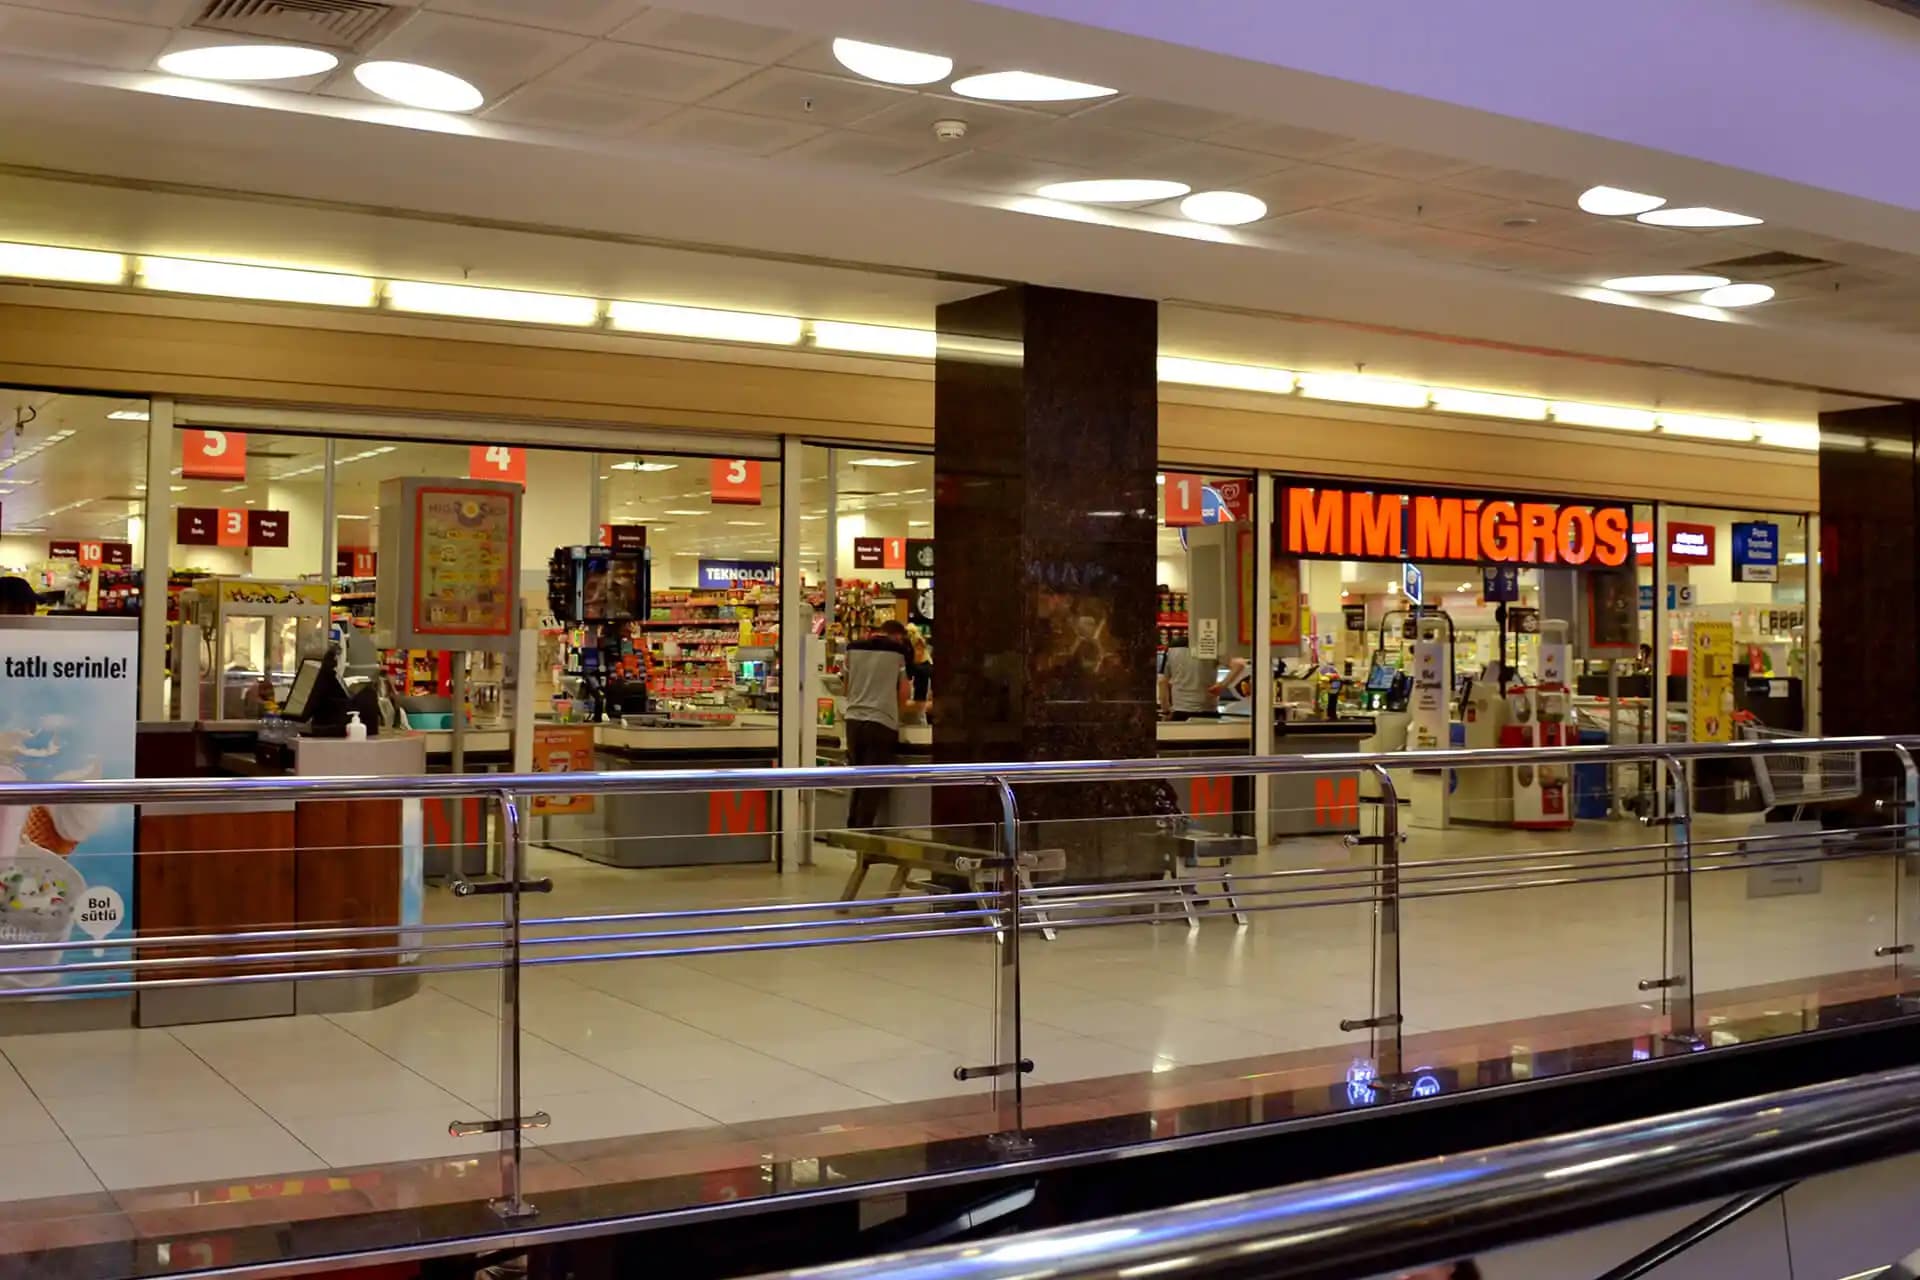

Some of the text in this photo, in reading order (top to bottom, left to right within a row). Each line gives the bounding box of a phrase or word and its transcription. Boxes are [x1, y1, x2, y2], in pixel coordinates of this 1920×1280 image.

[485, 446, 511, 471] 4
[1176, 479, 1190, 511] 1
[226, 511, 242, 534] 3
[1288, 487, 1401, 557] MM
[83, 544, 100, 561] 10
[357, 553, 372, 569] 11
[890, 540, 900, 560] 1
[5, 656, 128, 680] tatlı serinle!
[1315, 777, 1357, 826] M
[88, 897, 111, 910] Bol
[80, 908, 118, 923] sütlü
